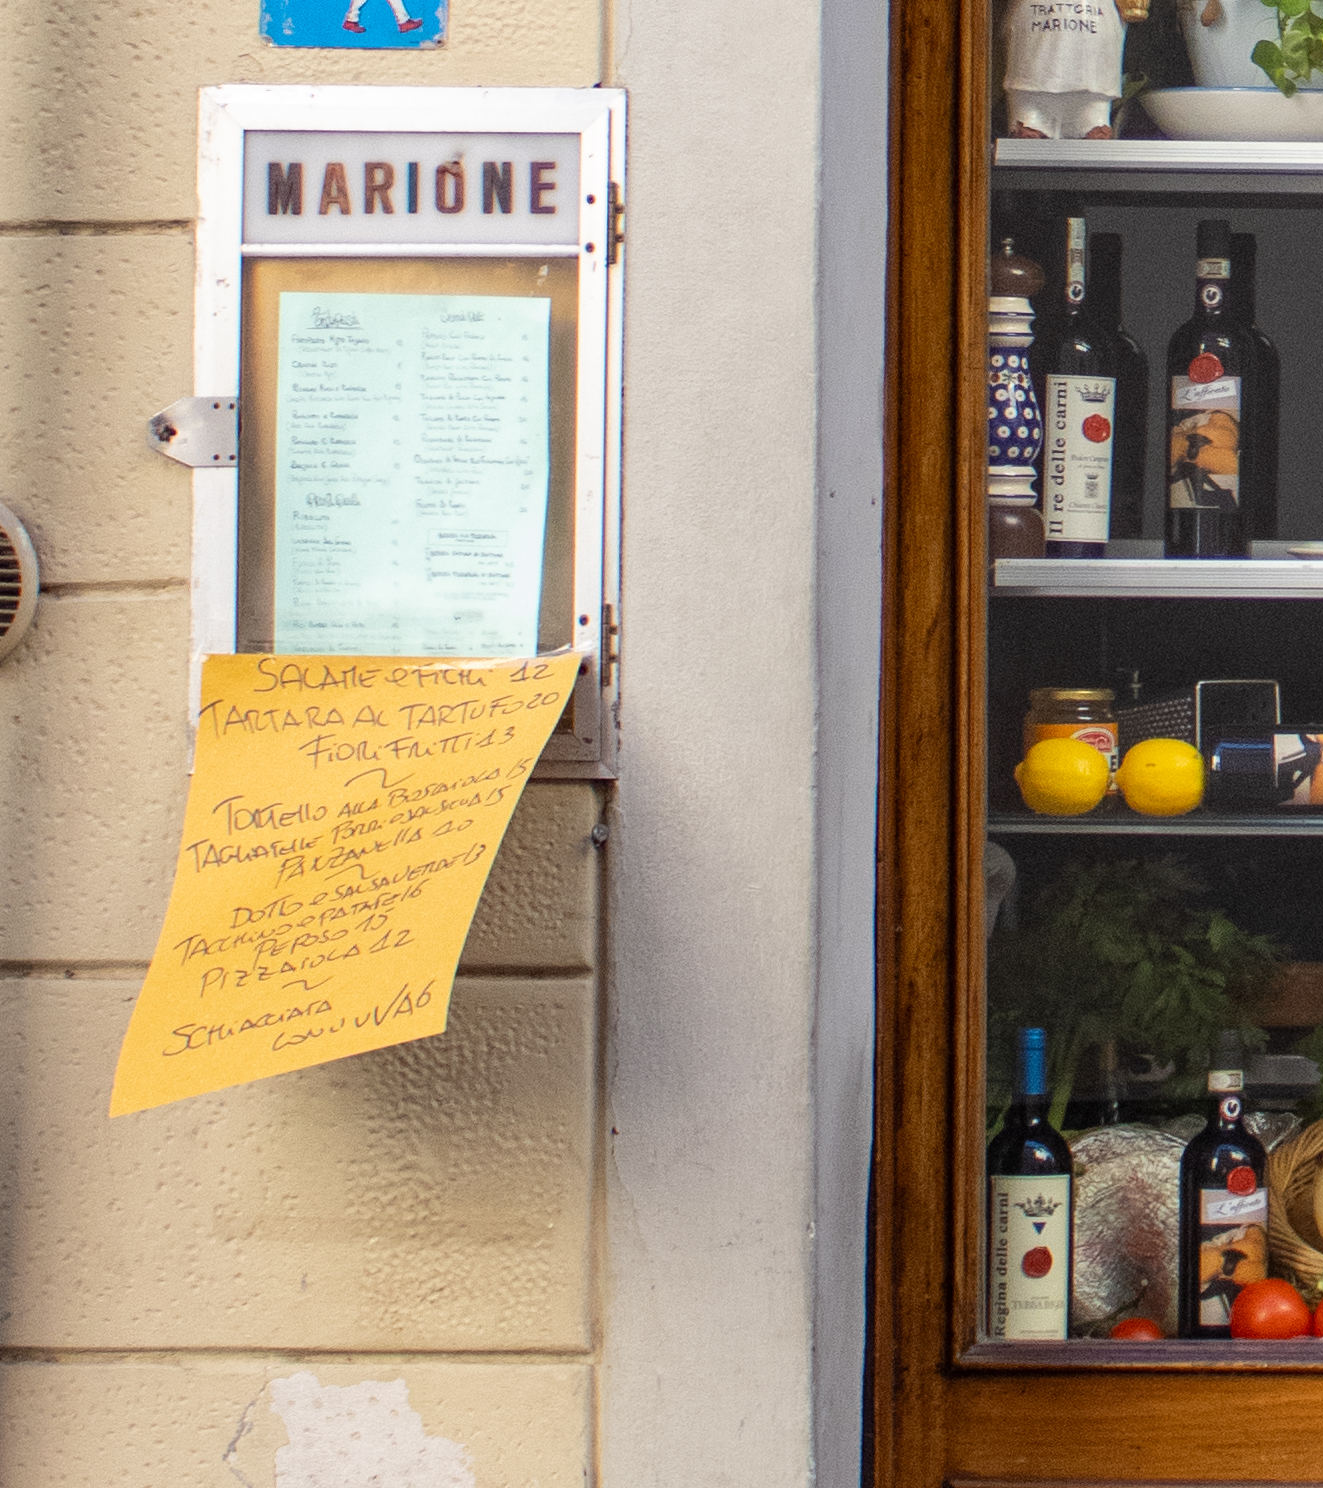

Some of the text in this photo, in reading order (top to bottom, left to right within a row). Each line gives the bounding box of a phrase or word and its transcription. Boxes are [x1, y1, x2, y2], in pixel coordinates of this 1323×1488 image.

[1030, 3, 1104, 16] TRATTORIA
[1031, 18, 1098, 34] MARIONE
[266, 159, 559, 216] MARIONE
[1054, 381, 1067, 431] carni
[1051, 437, 1066, 486] delle
[1053, 494, 1064, 513] re
[254, 657, 380, 692] SALAME
[510, 662, 555, 683] 12
[506, 757, 534, 780] 15
[484, 785, 512, 807] 15
[369, 929, 415, 953] 12
[998, 1192, 1008, 1233] carni
[997, 1238, 1008, 1274] delle
